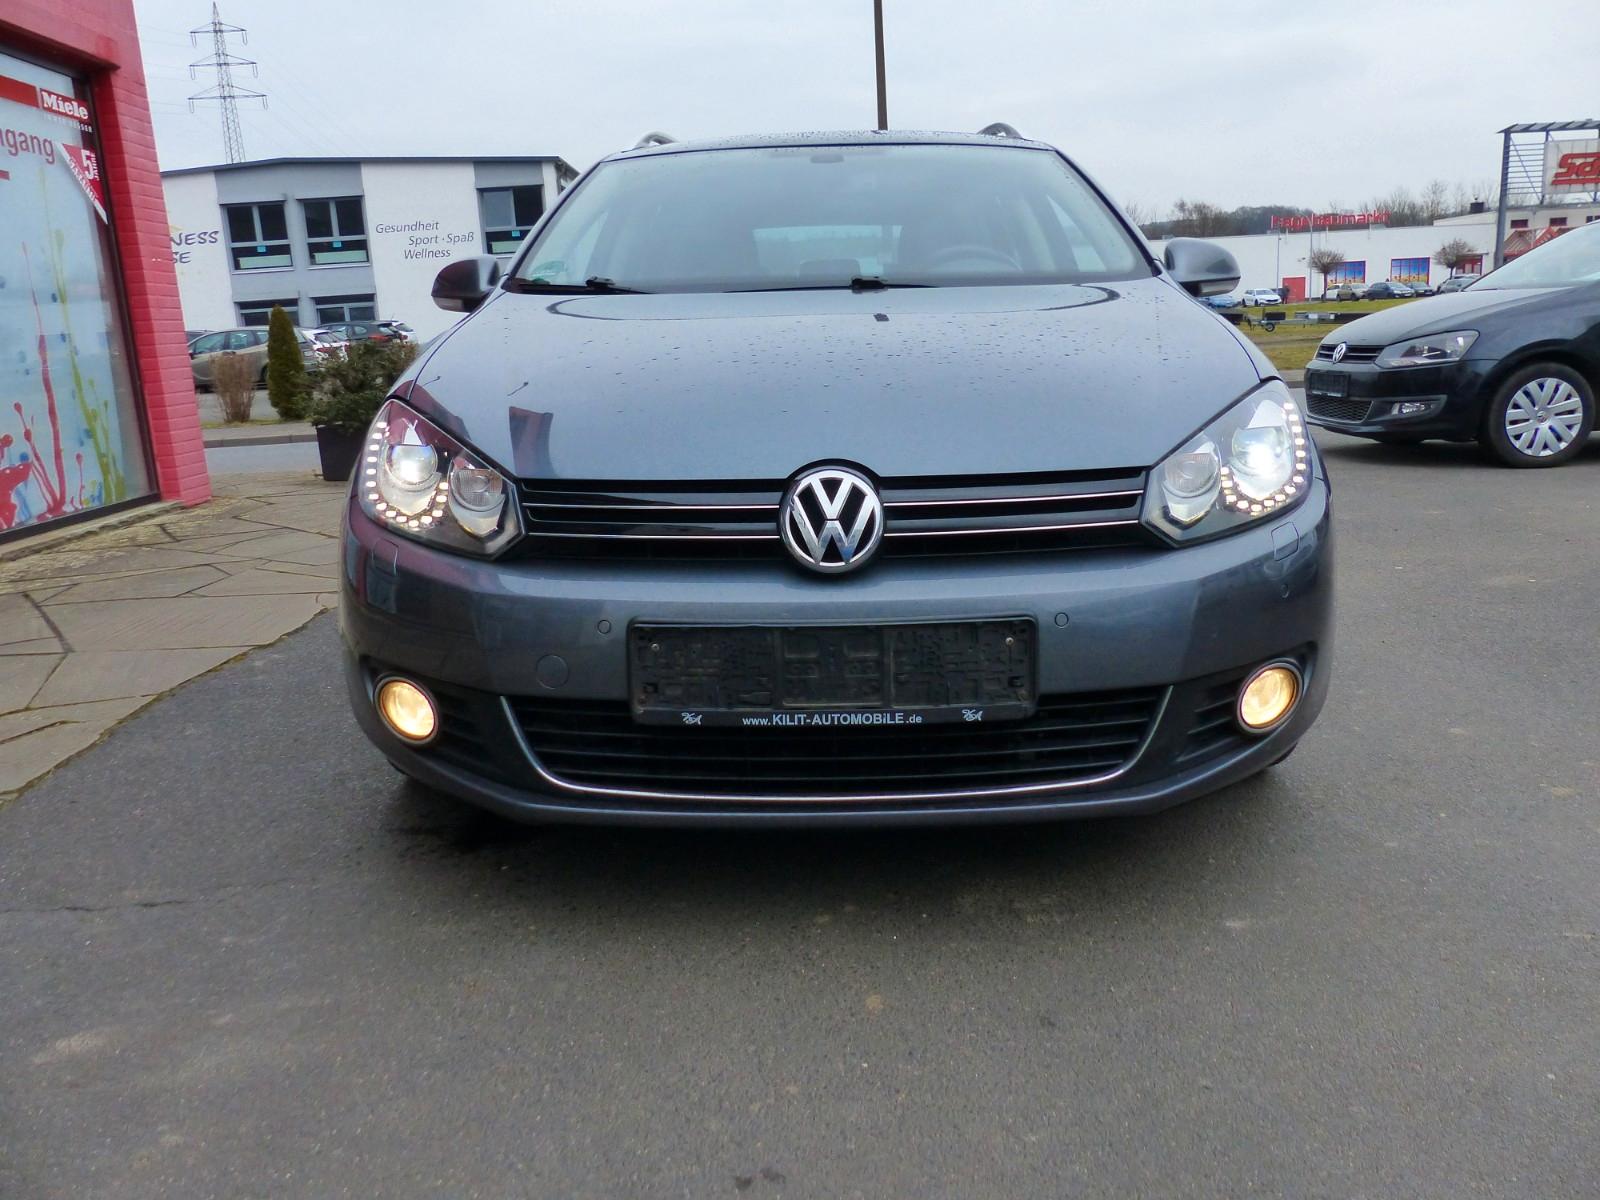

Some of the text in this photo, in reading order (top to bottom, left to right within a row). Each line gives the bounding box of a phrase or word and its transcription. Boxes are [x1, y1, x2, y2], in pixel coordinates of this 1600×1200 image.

[41, 91, 89, 119] Miele
[375, 221, 440, 234] Gesundheit
[408, 231, 475, 247] Sport Spaß
[404, 248, 451, 259] Wellness
